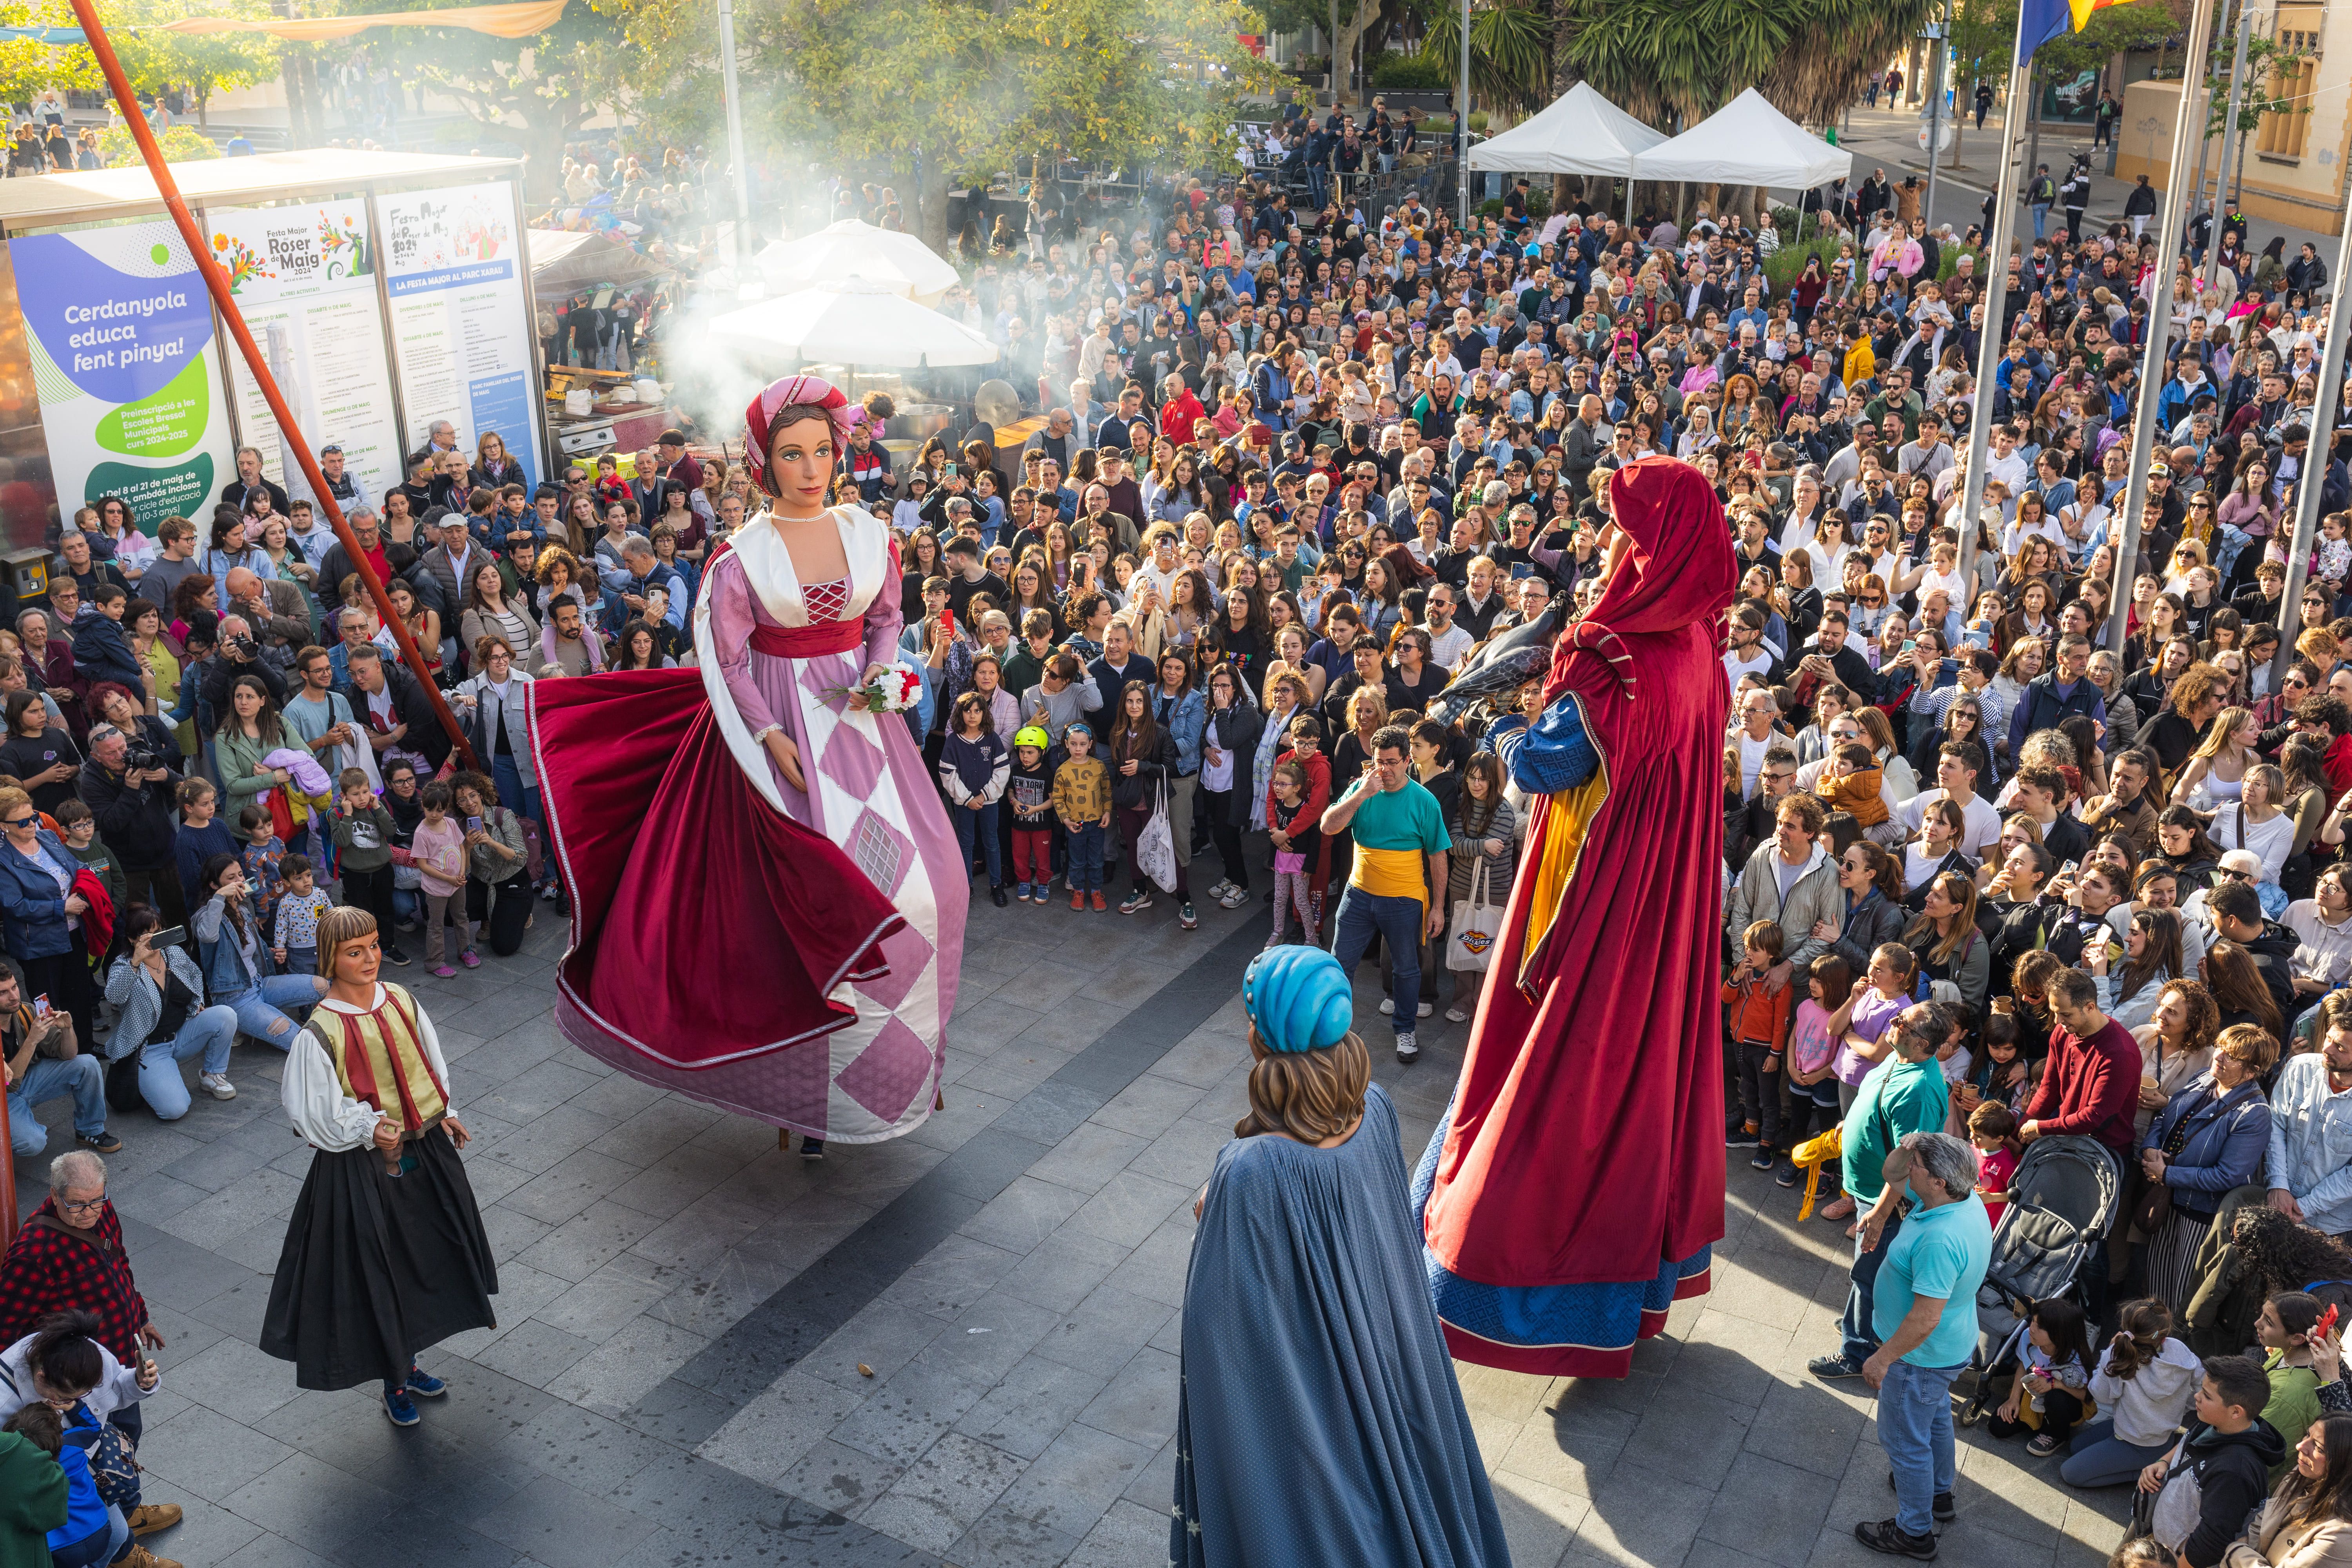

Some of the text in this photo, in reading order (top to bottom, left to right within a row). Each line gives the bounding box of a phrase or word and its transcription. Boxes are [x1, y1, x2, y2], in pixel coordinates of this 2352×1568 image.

[390, 201, 447, 227] Festa Major
[267, 227, 307, 238] Festa Major
[391, 222, 448, 241] del Roser de Maig
[268, 238, 310, 254] Roser
[392, 240, 417, 254] 2024
[280, 251, 319, 270] Maig
[396, 267, 503, 290] LA FESTA MAJOR AL PARC XARAU
[65, 290, 187, 324] Cerdanyola
[399, 305, 423, 313] DIVENDRES
[69, 325, 136, 348] educa
[74, 338, 184, 372] fent pinya!
[121, 401, 175, 419] Preinscripció
[184, 398, 195, 409] les
[123, 410, 185, 429] Escoles Bressol
[125, 424, 169, 439] Municipals
[126, 430, 188, 449] curs 2024-2025
[107, 471, 196, 497] Del 8 al 21 de maig de
[133, 489, 167, 503] ambdós
[168, 481, 201, 495] inclosos
[143, 499, 157, 510] cicle
[158, 490, 201, 506] d'educació
[143, 512, 157, 522] (0-3
[158, 504, 180, 518] anys)
[981, 750, 991, 761] Y
[1015, 779, 1044, 790] EW YORK
[394, 874, 416, 882] ARCELONA
[1991, 901, 2005, 913] RACING
[1461, 935, 1490, 946] Dickies
